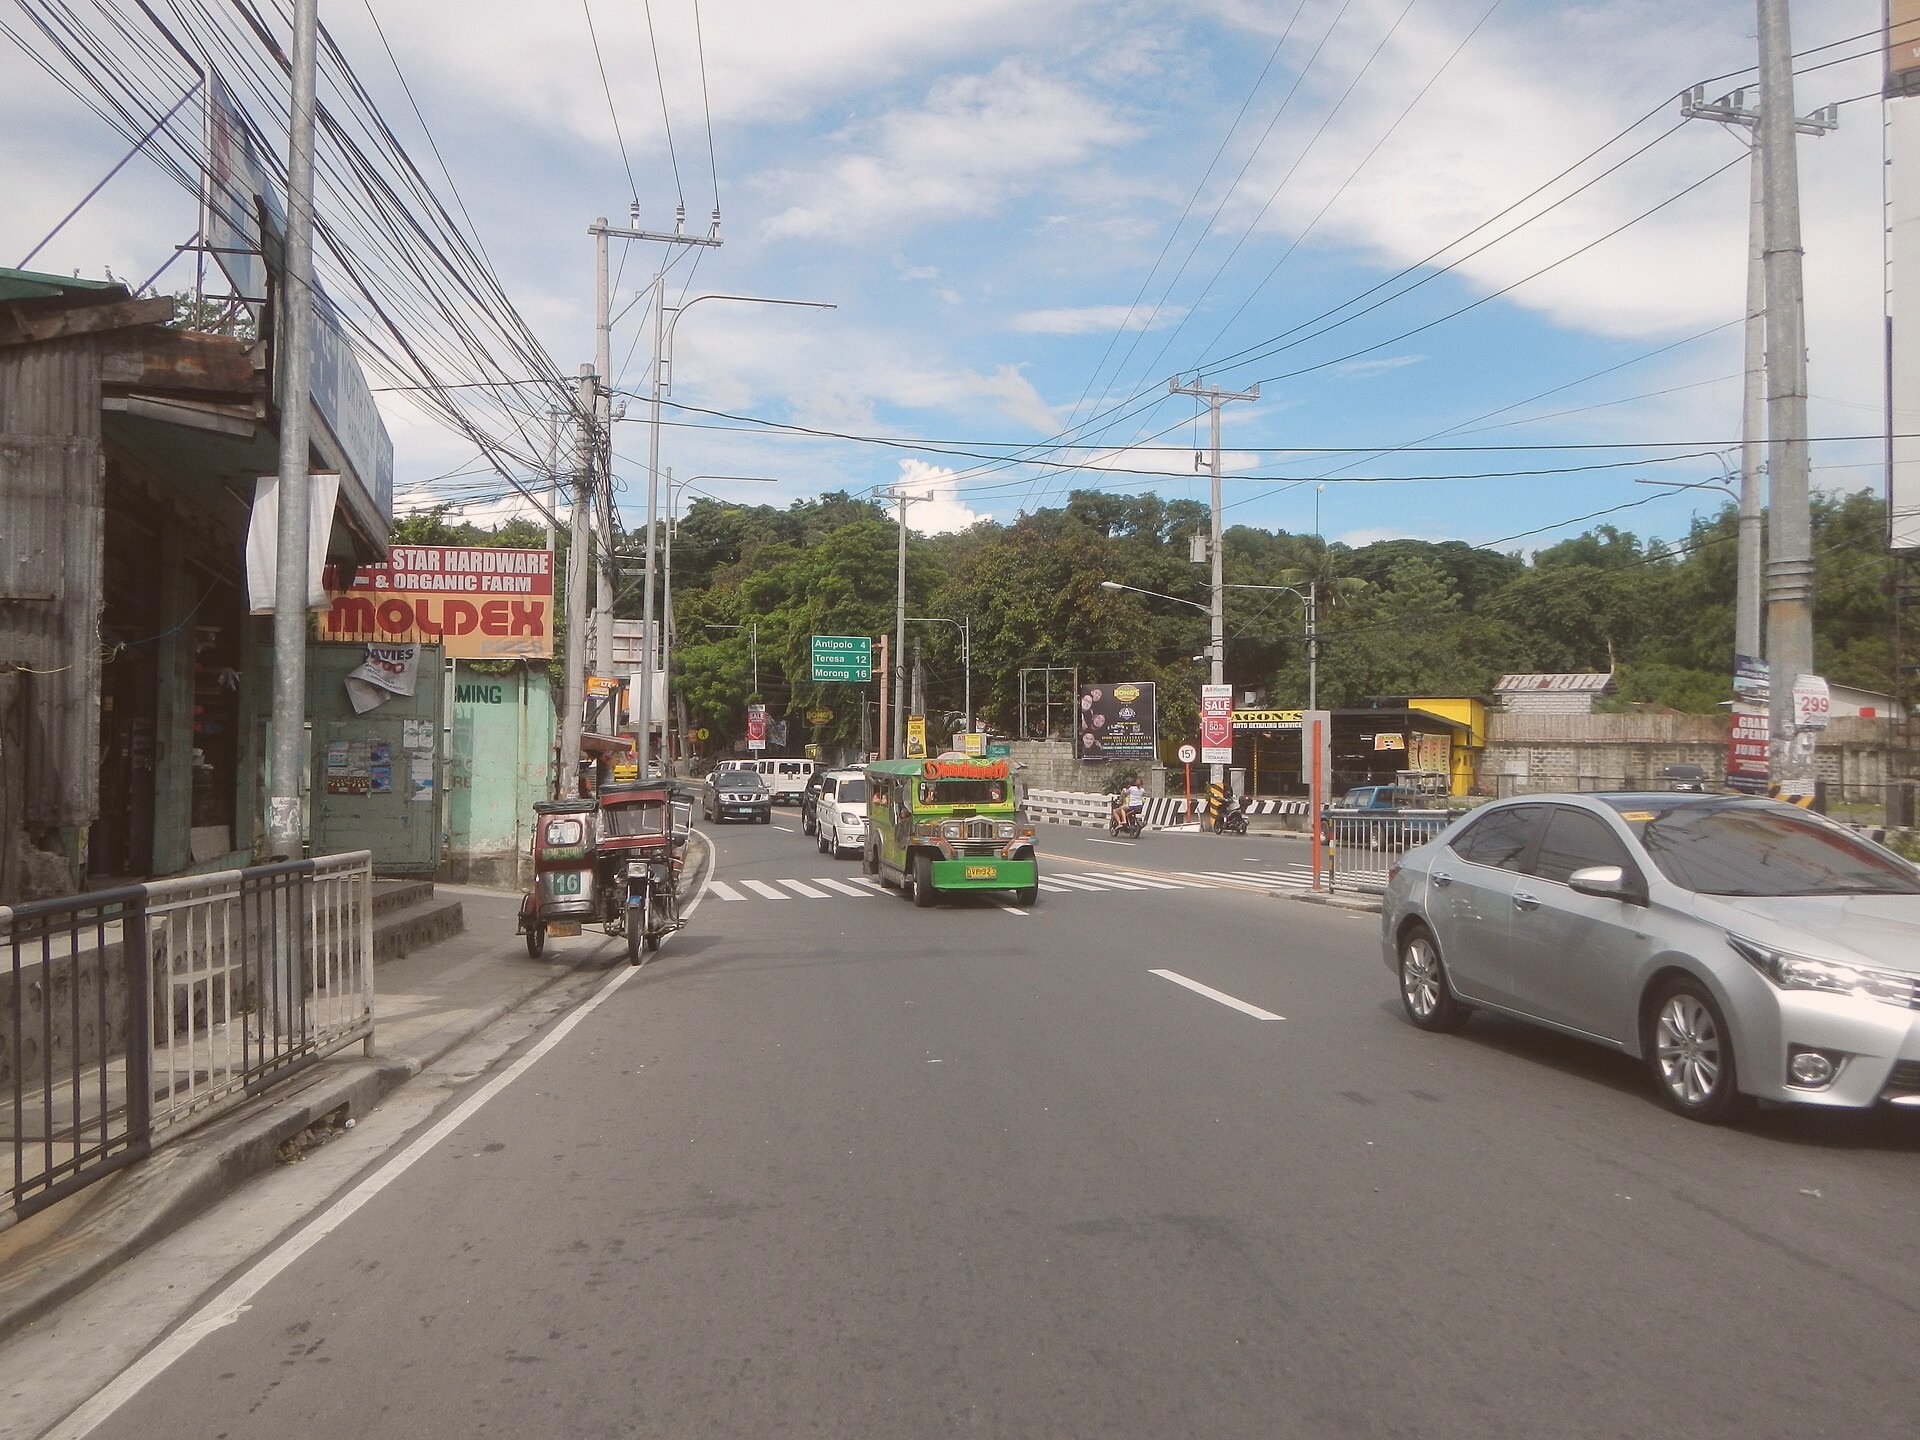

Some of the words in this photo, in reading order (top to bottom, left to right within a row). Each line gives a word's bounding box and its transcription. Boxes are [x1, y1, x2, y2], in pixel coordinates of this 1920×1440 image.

[392, 549, 440, 571] STAR
[445, 551, 549, 574] HARDWARE
[375, 574, 389, 589] &
[393, 573, 477, 591] ORGANIC
[482, 577, 531, 591] FARM
[328, 597, 544, 636] MOLDEX
[815, 640, 852, 649] Antipolo
[860, 641, 866, 649] 4
[815, 654, 845, 663] Teresa
[855, 655, 867, 664] 12
[815, 669, 850, 679] Morong
[855, 670, 867, 678] 16
[455, 685, 502, 704] MING
[1204, 701, 1230, 711] SALE
[1801, 696, 1829, 713] 299
[1209, 723, 1219, 731] 50
[556, 874, 578, 892] 16
